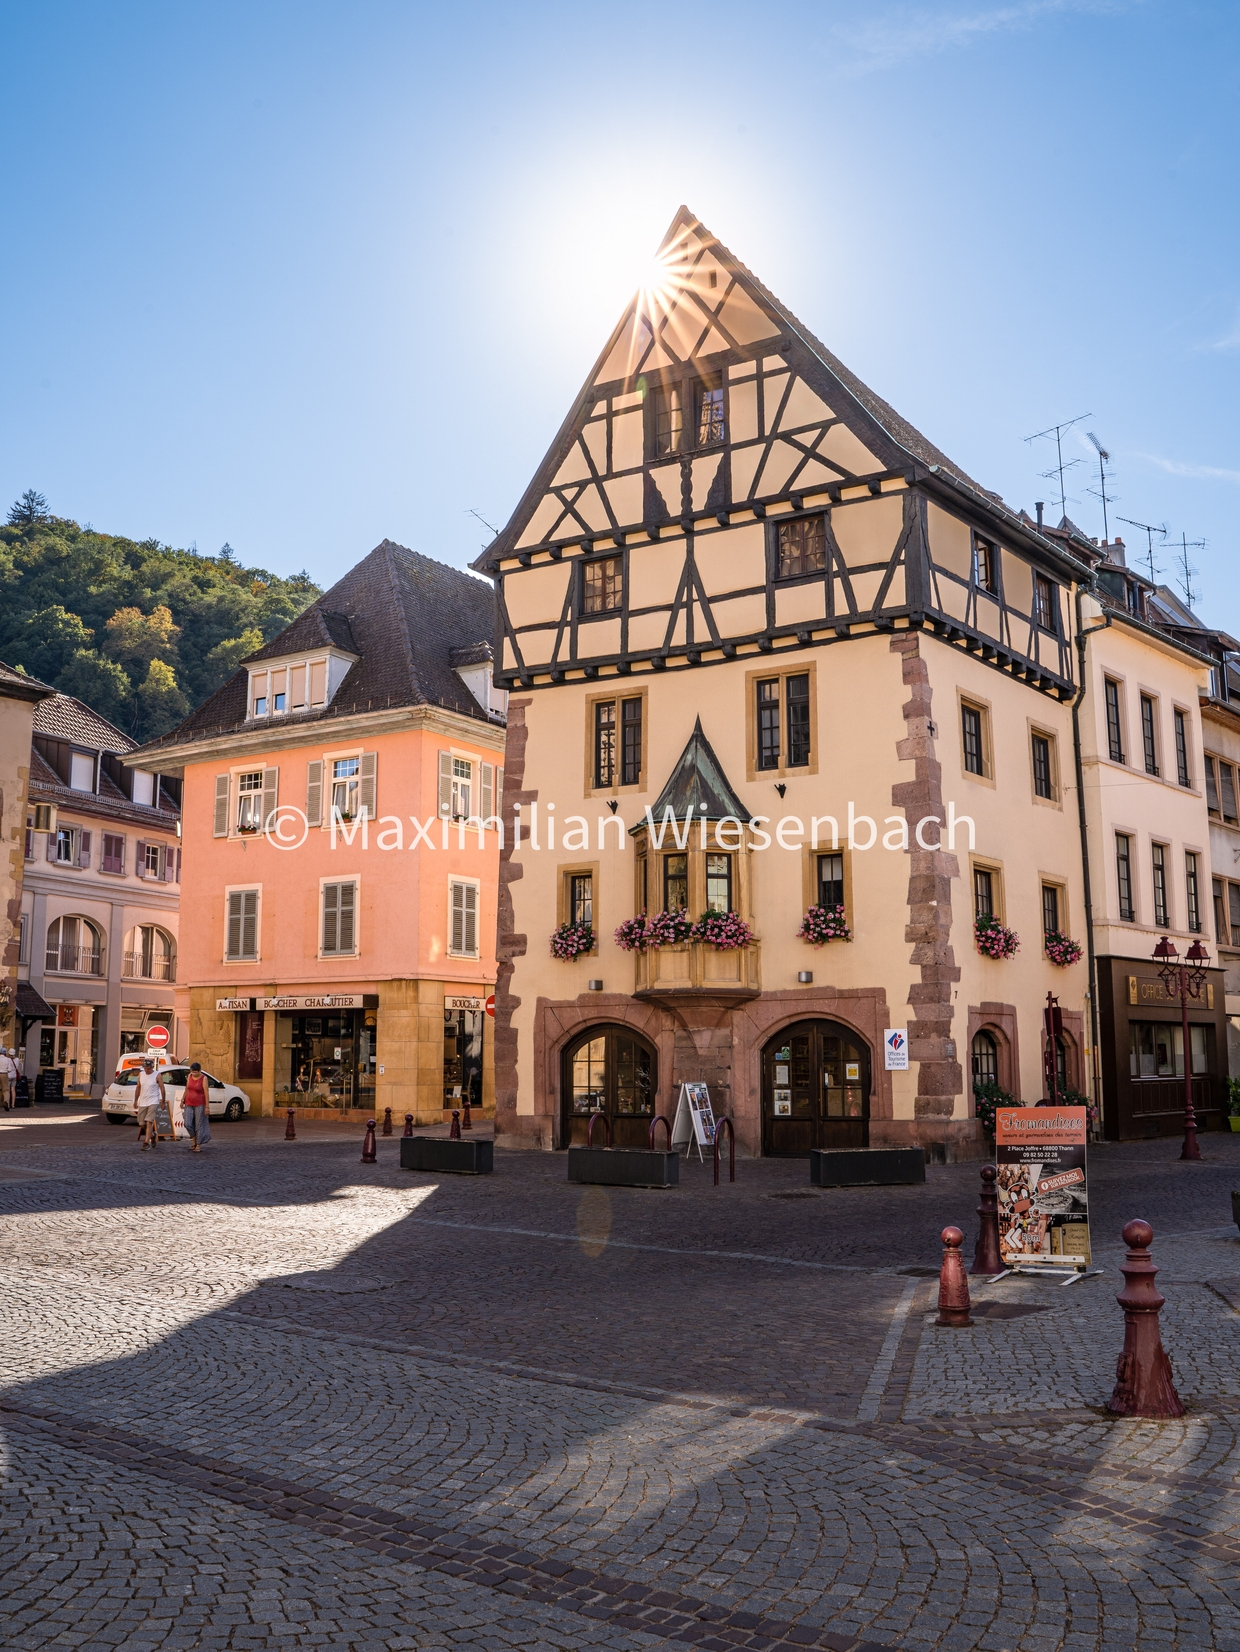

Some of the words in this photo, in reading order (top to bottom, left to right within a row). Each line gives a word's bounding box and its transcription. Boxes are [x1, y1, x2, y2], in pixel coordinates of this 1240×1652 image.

[1141, 984, 1163, 1000] OFFICE
[218, 1000, 248, 1009] ATISAN
[999, 1112, 1083, 1131] Fromandises
